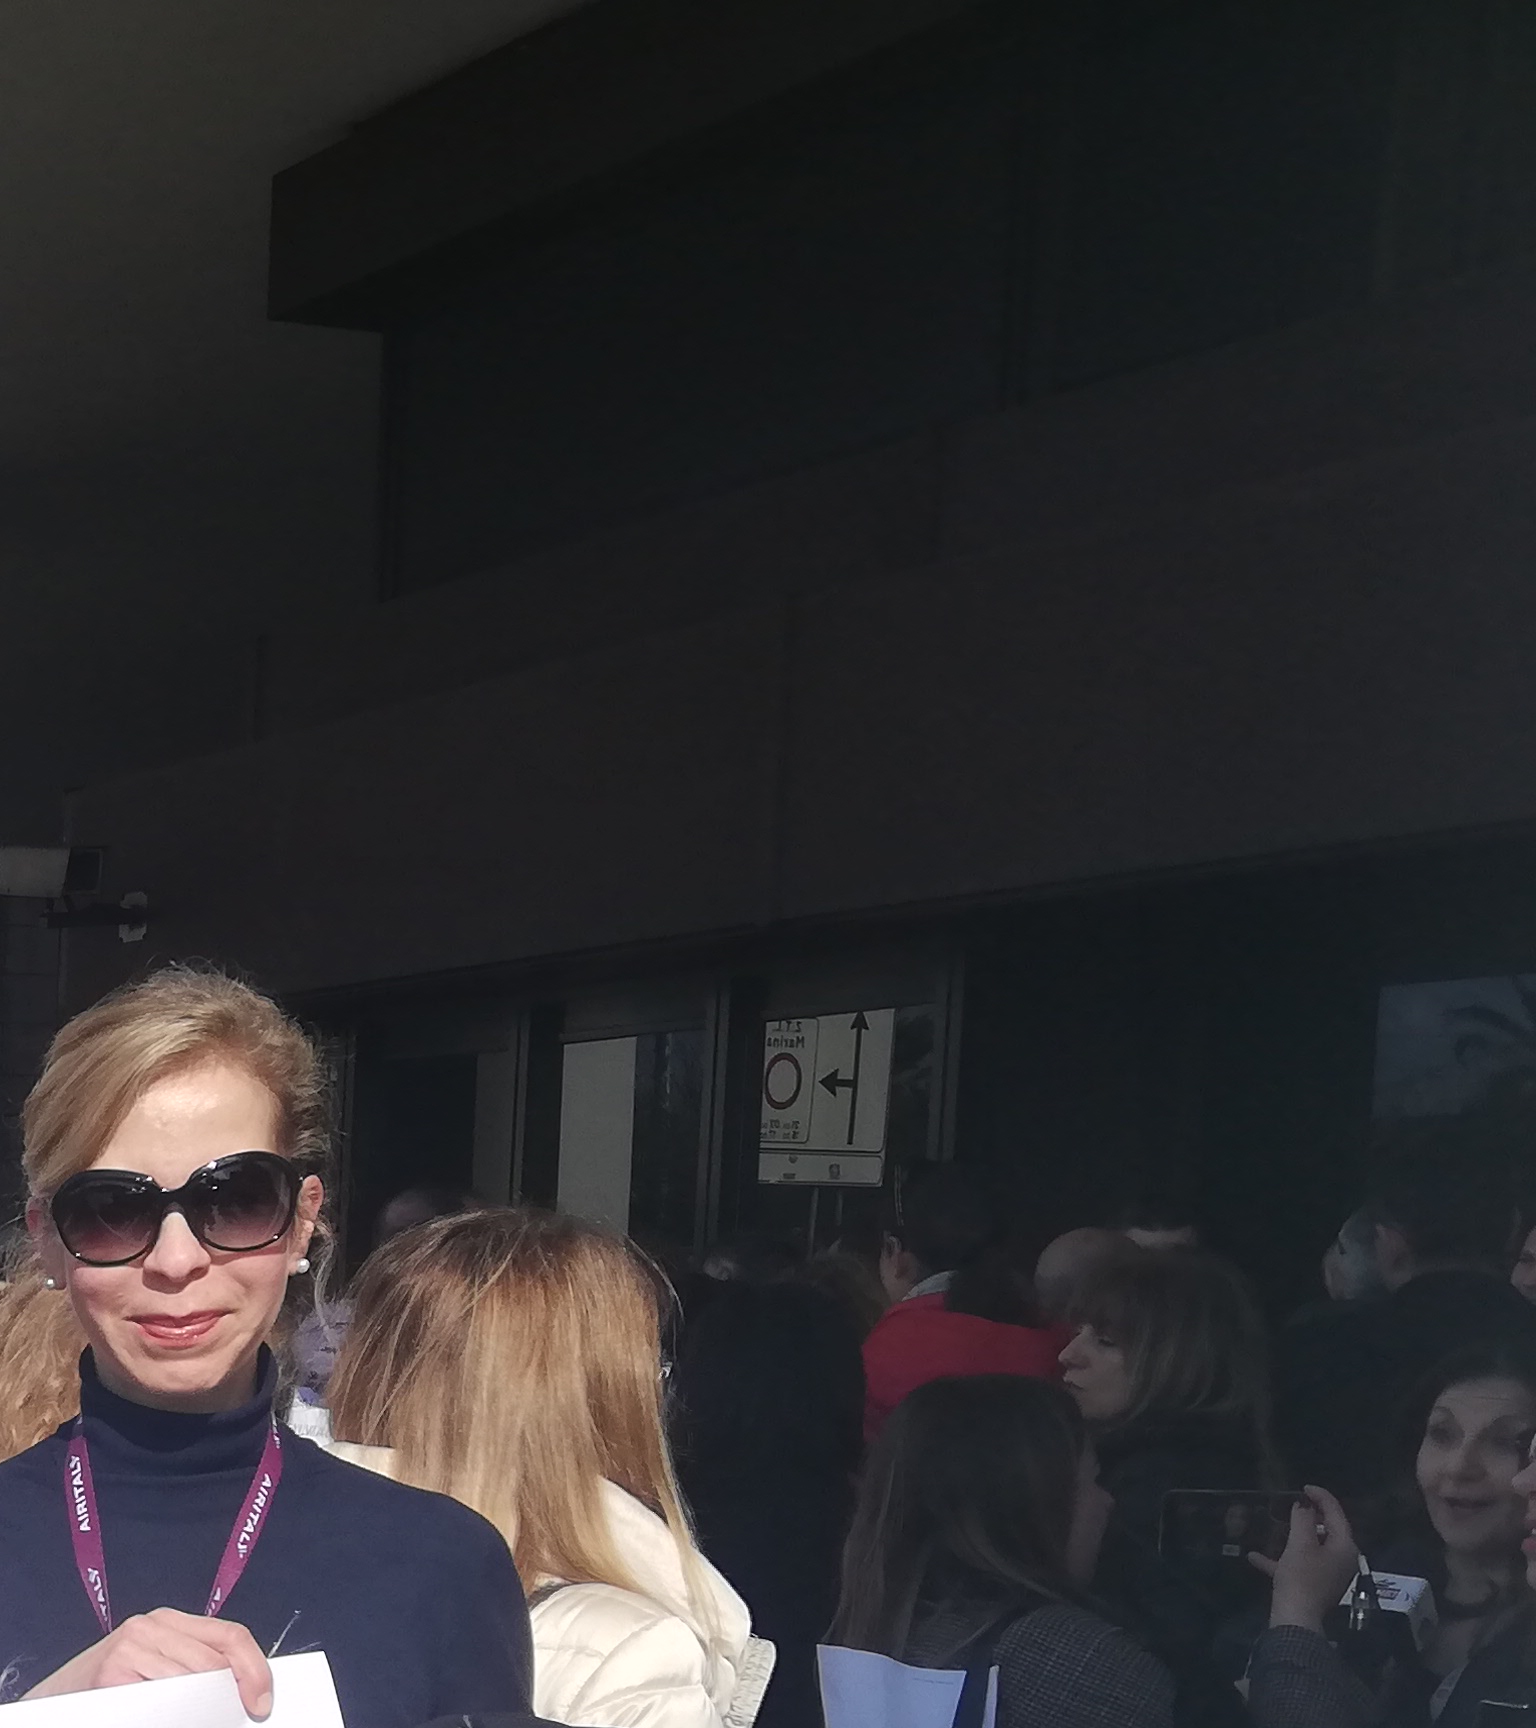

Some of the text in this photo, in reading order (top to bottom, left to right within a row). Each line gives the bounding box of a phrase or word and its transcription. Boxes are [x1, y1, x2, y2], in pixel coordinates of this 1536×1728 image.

[68, 1455, 92, 1532] AIRITALY
[236, 1474, 273, 1560] AIRITALY
[87, 1567, 108, 1622] TALY
